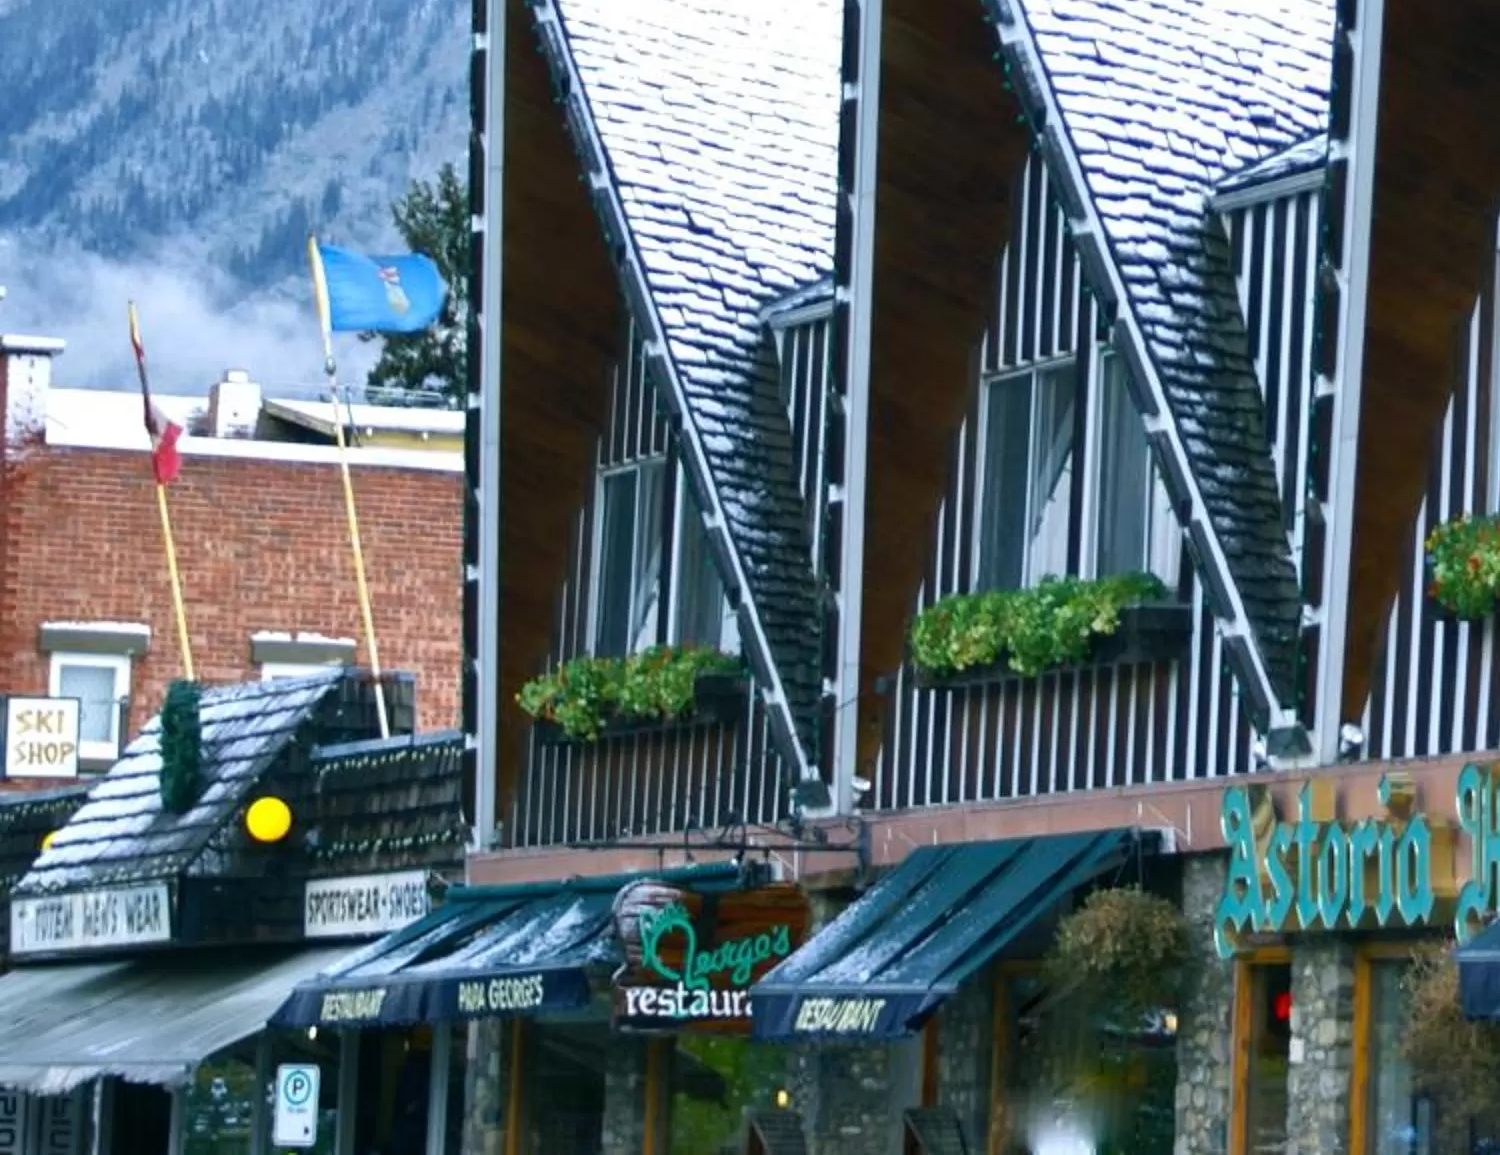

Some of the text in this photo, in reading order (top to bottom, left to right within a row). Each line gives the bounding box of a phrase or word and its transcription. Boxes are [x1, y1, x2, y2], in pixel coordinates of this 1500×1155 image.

[15, 709, 65, 736] SKI
[13, 740, 75, 766] SHOP
[1214, 773, 1434, 959] Astoria
[308, 886, 381, 925] SPORTSWEAR
